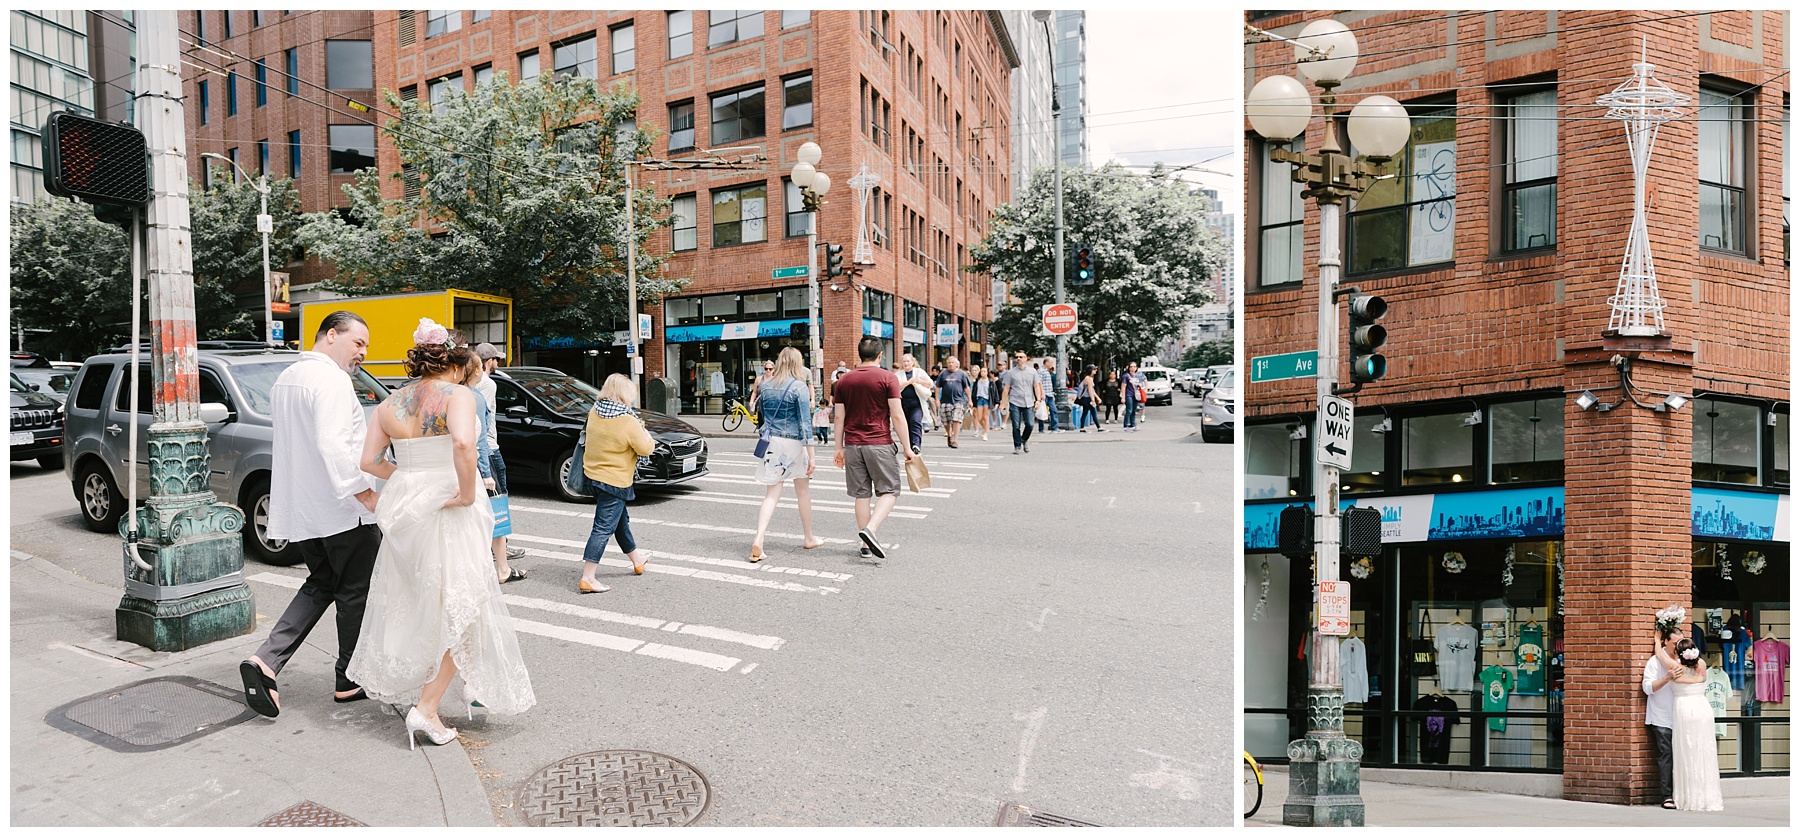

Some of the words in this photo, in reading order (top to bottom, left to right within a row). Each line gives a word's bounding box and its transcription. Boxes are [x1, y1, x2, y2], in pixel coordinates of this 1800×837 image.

[275, 329, 280, 337] 2
[1257, 360, 1269, 379] 1st
[1295, 358, 1313, 372] Ave
[1327, 401, 1350, 422] ONE
[1325, 419, 1351, 441] WAY
[1322, 583, 1335, 592] NO
[1322, 595, 1348, 605] STOPS
[1414, 652, 1433, 663] NIRV
